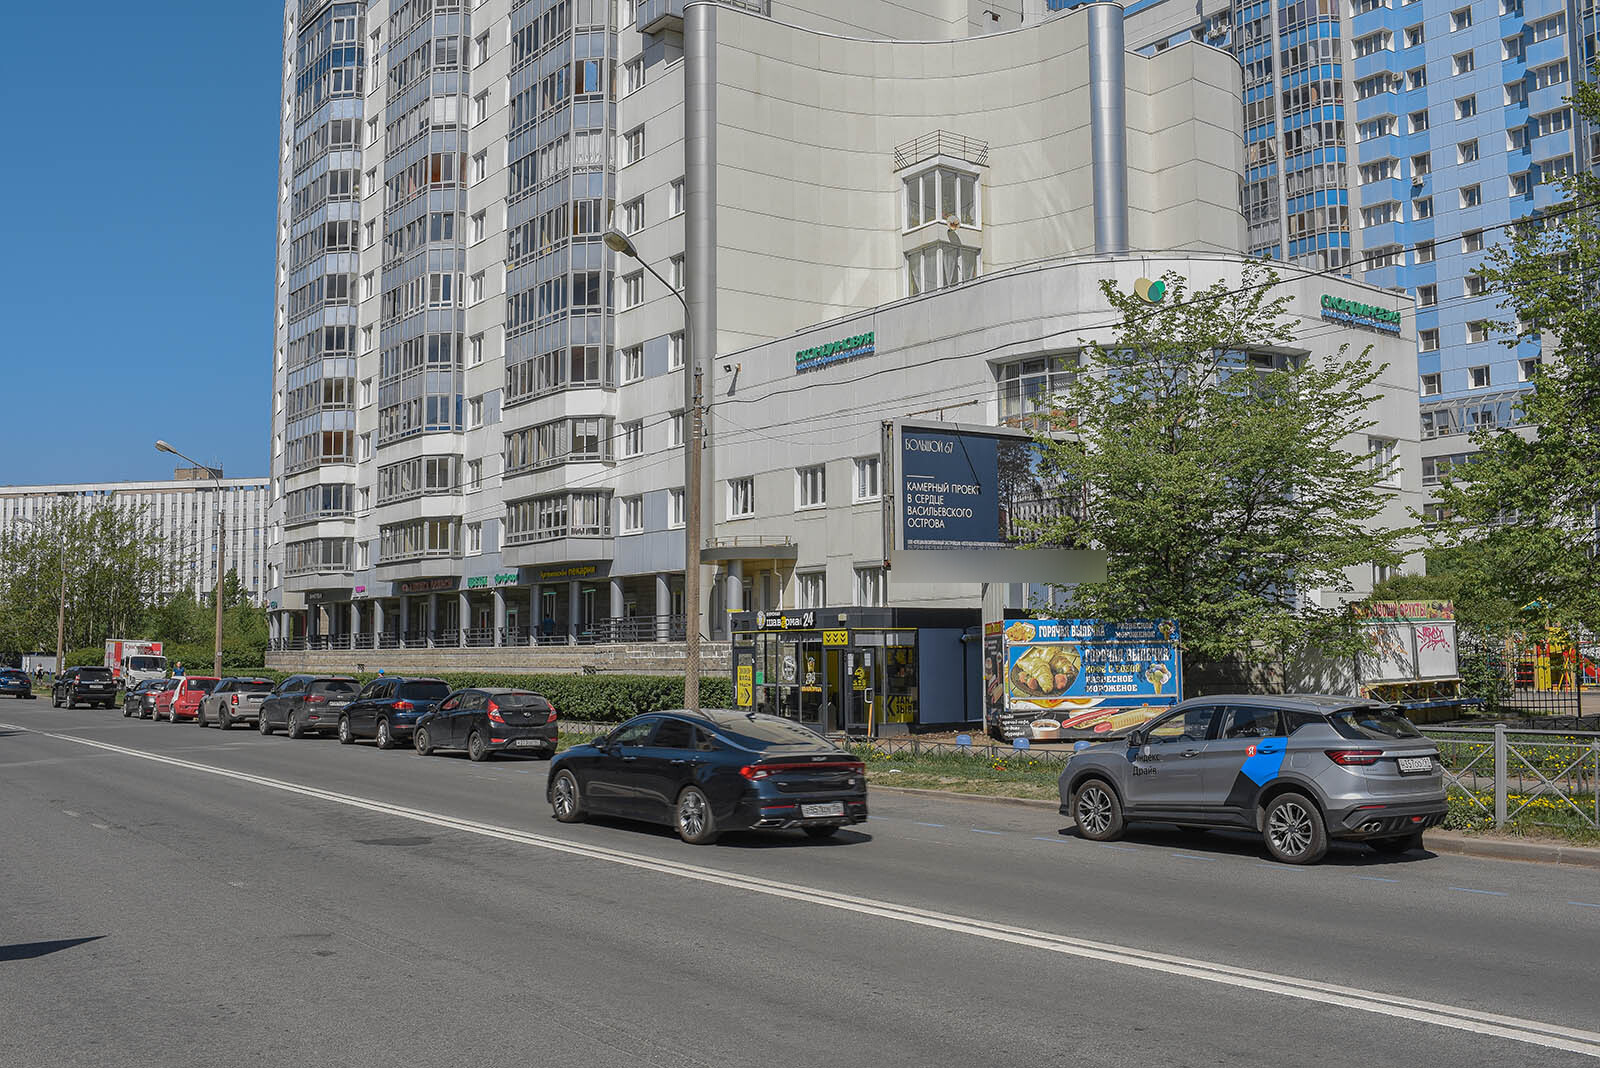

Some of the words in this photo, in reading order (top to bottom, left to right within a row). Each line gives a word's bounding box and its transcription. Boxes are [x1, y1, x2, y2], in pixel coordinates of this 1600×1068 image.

[905, 438, 943, 453] БОЛЬШОЙ
[944, 441, 954, 454] 67
[906, 481, 949, 493] КАМЕРНЫЙ
[951, 484, 980, 495] ПРОЕКТ
[907, 494, 912, 503] В
[915, 494, 944, 505] СЕРДЦЕ
[907, 505, 973, 518] ВАСИЛЬЕВСКОГО
[907, 518, 945, 528] ОСТРОВА
[1399, 602, 1427, 617] ФРУКТЫ
[803, 611, 814, 627] 24
[1085, 647, 1124, 662] ГОРЯЧАЯ
[1126, 647, 1170, 661] ВЫПЕЧКА
[1133, 766, 1158, 776] Драйв
